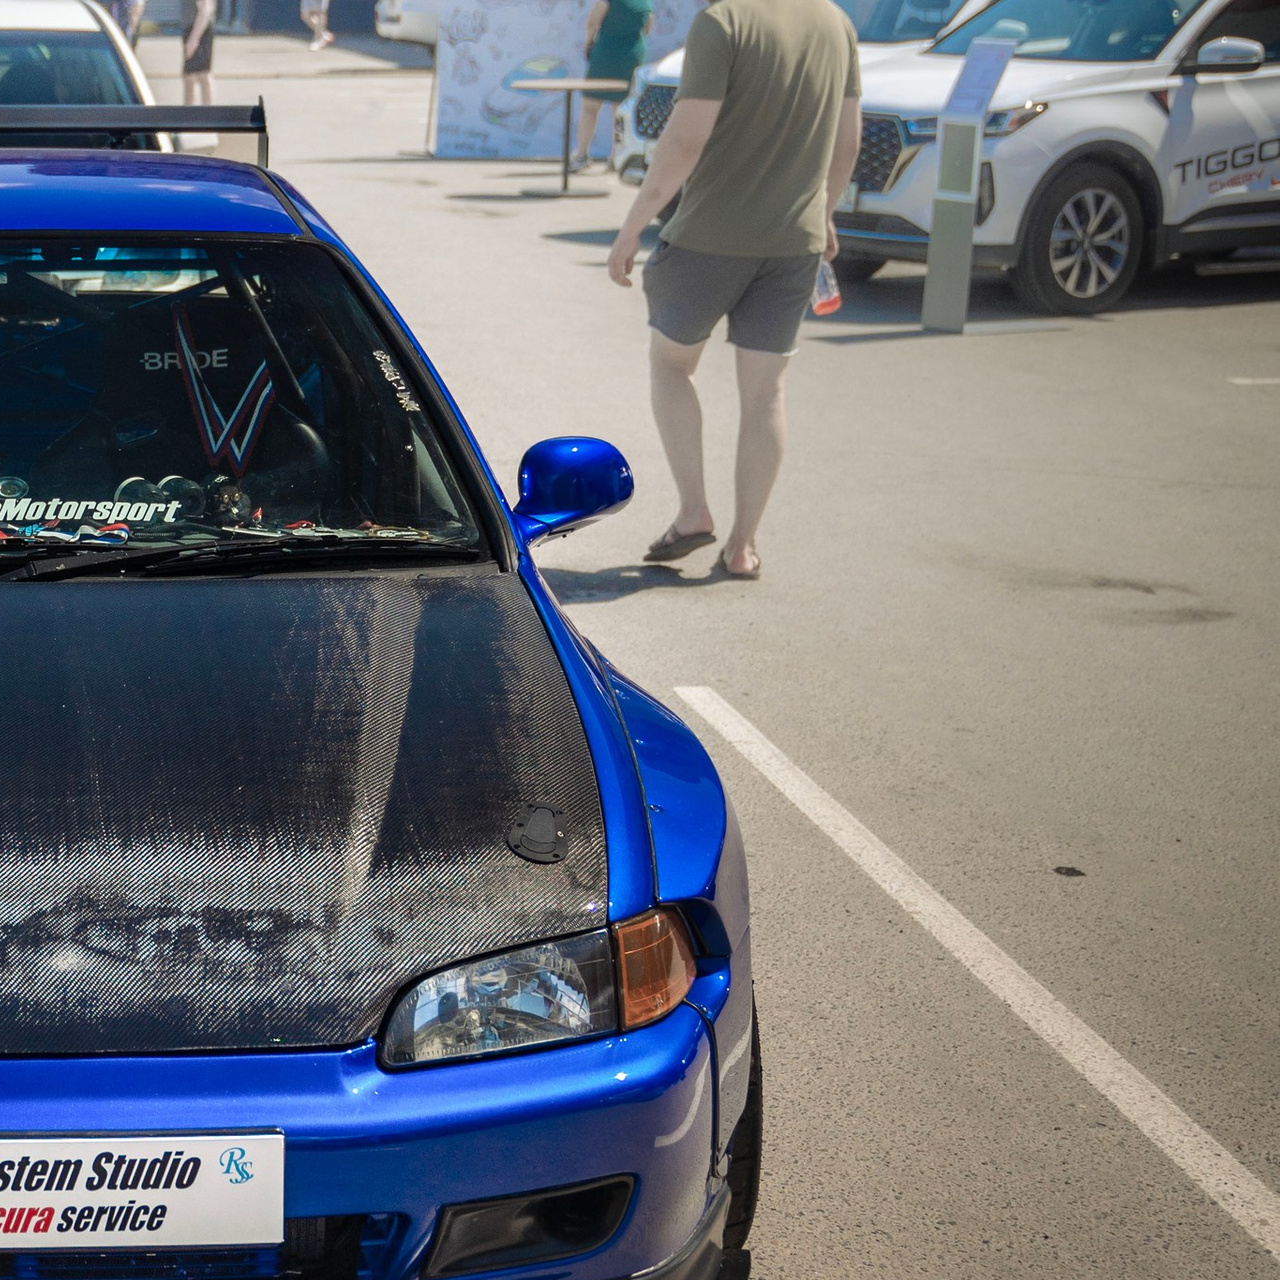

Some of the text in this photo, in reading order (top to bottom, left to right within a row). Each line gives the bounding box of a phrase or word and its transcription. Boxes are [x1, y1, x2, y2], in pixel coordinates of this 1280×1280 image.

[140, 348, 229, 371] BRDE
[85, 1150, 201, 1191] Studio
[57, 1199, 168, 1233] service
